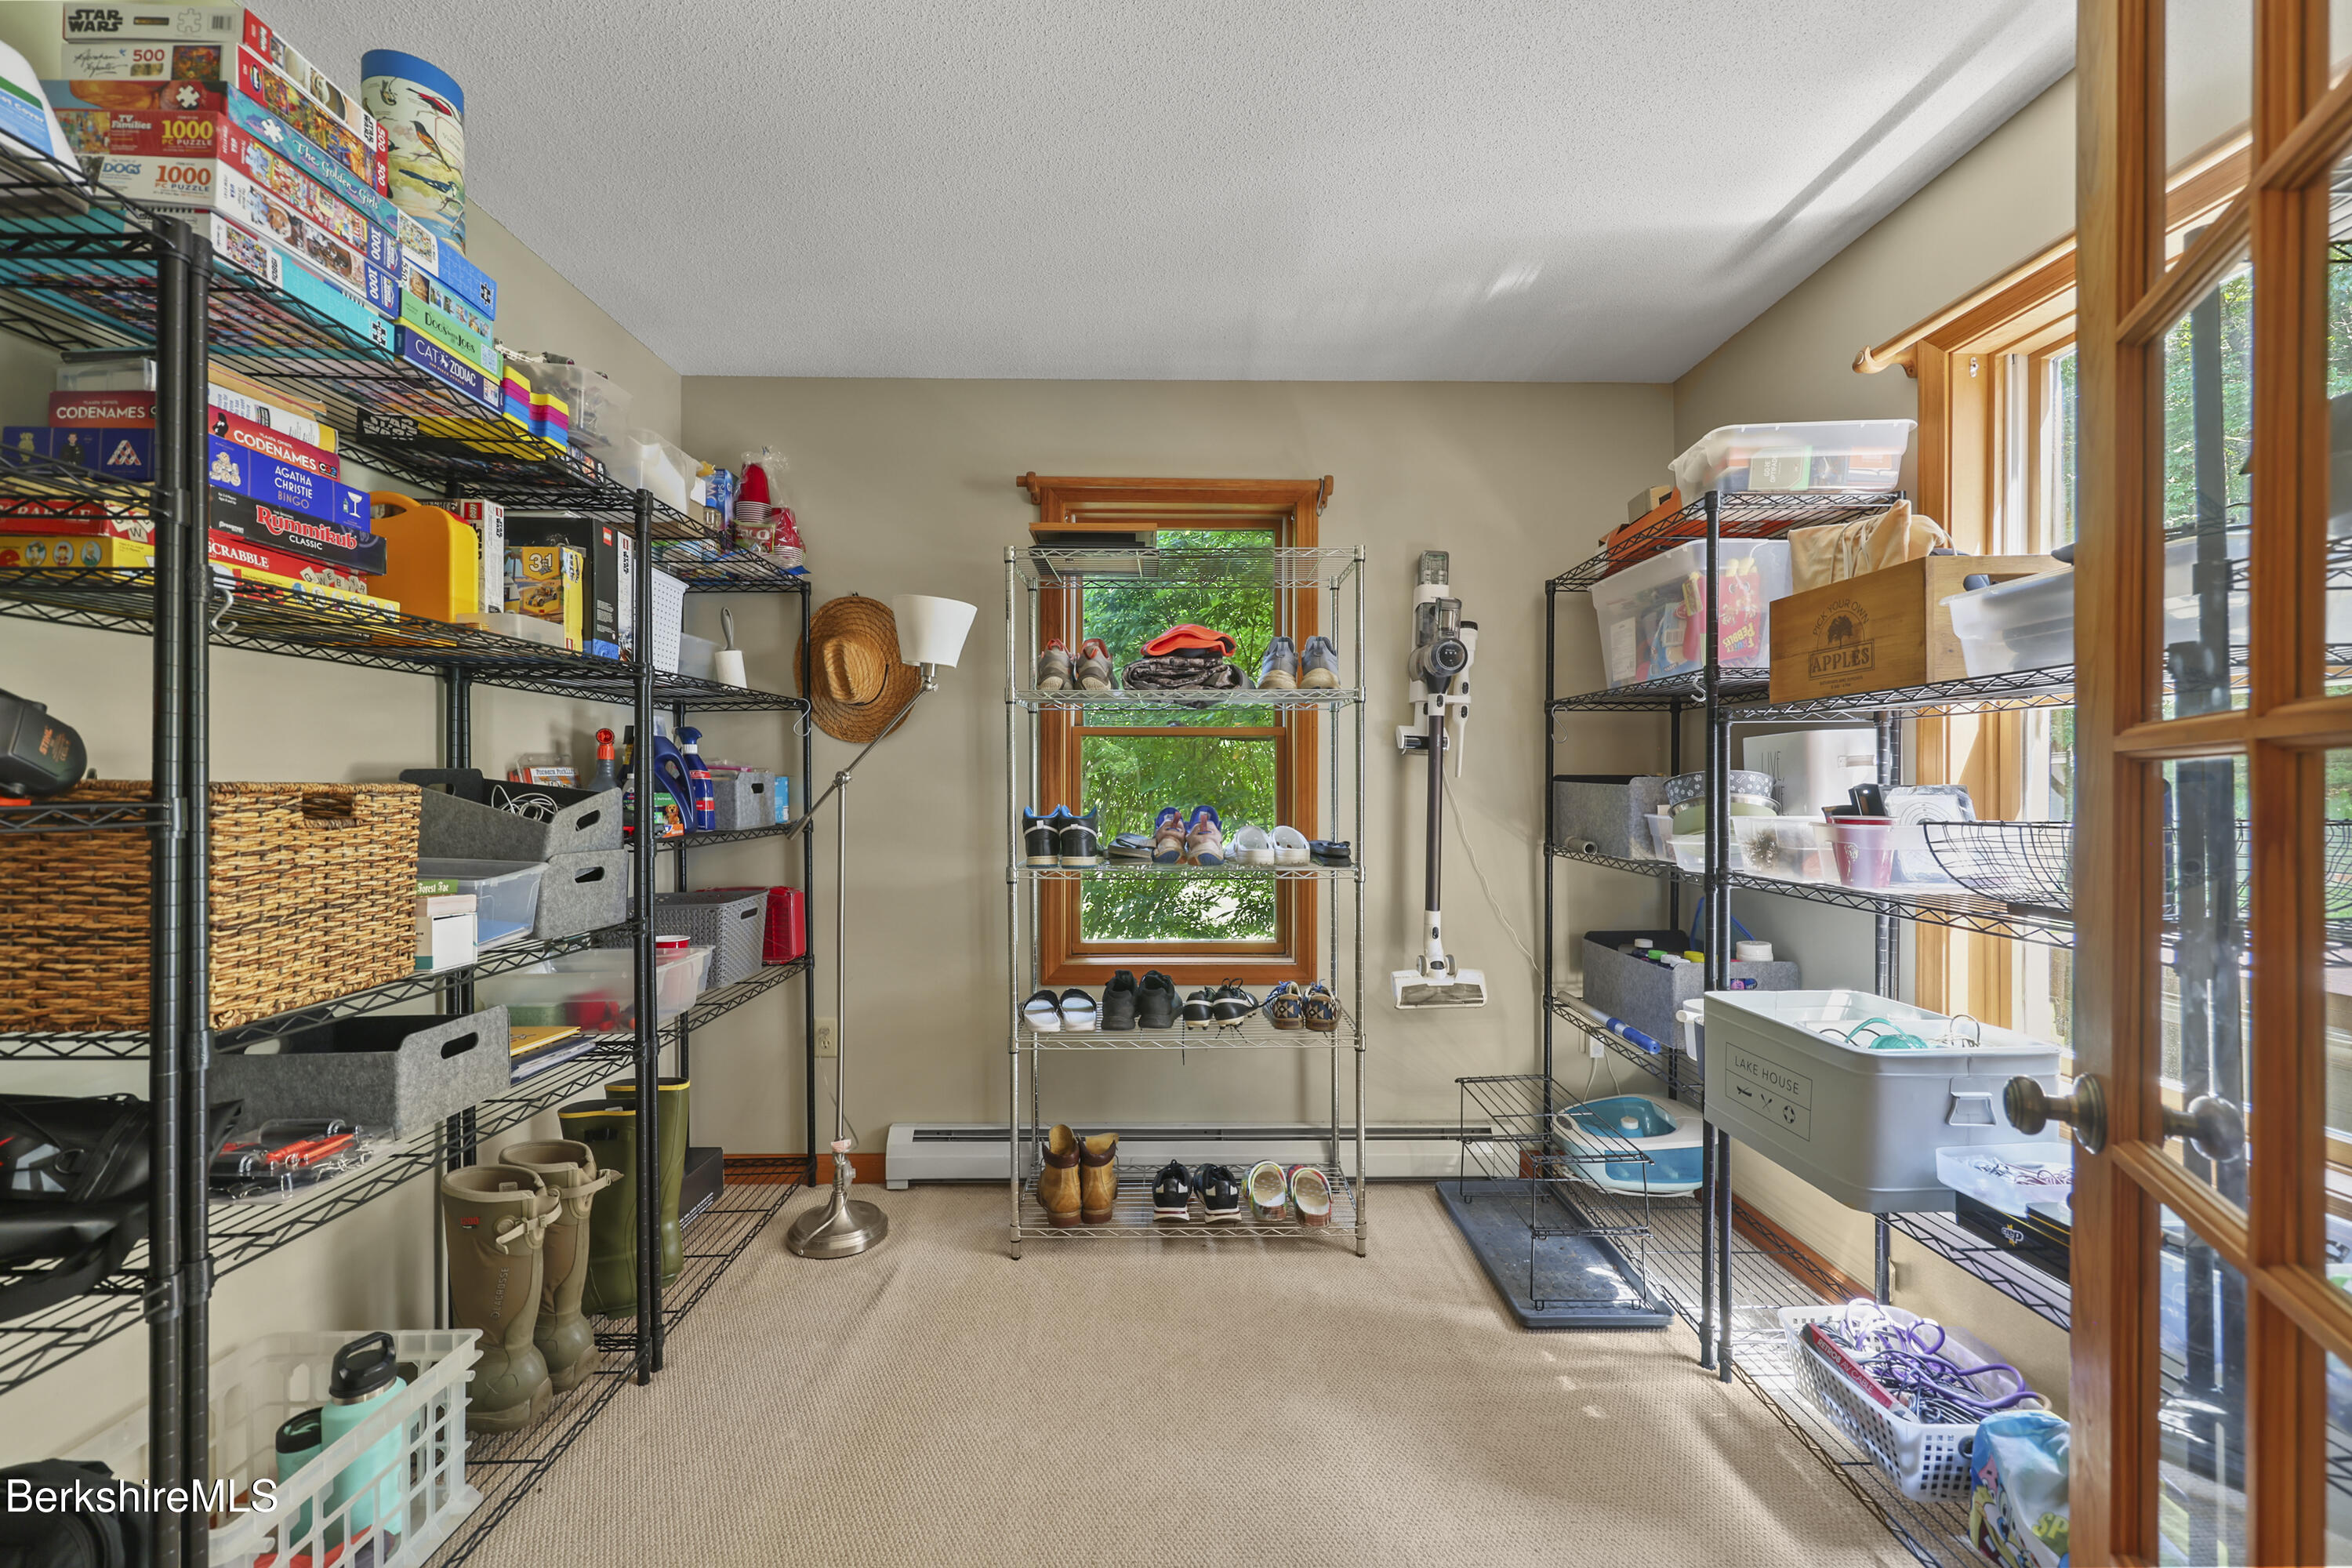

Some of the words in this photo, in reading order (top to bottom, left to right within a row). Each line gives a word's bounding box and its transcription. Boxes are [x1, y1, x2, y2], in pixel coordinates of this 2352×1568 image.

[68, 9, 123, 20] STAR
[68, 21, 123, 32] WARS
[132, 49, 165, 62] 500
[111, 120, 152, 130] Families
[161, 120, 214, 140] 1000
[377, 125, 386, 152] 500
[102, 162, 142, 175] DOGS
[155, 165, 212, 187] 1000
[292, 140, 321, 167] The
[321, 162, 358, 194] Golden
[359, 188, 379, 210] Girls
[377, 162, 386, 187] 500
[170, 183, 210, 192] PUZZLE
[370, 226, 382, 261] 1000
[368, 265, 379, 300] 1000
[425, 312, 448, 336] DOGS
[457, 333, 476, 354] JOBS
[415, 339, 439, 365] CAT
[449, 357, 477, 388] ZODIAC
[56, 406, 146, 419] CODENAMES
[233, 430, 317, 471] CODENAMES
[274, 465, 313, 488] AGATHA
[274, 477, 313, 499] CHRISTIE
[278, 490, 310, 510] BINGO
[256, 504, 358, 550] Rummikub
[289, 534, 323, 551] CLASSIC
[1813, 612, 1828, 636] PICK
[1828, 598, 1850, 613] YOUR
[1851, 601, 1870, 624] OWN
[1811, 648, 1870, 673] APPLES
[417, 882, 437, 895] Forest
[1735, 1055, 1758, 1076] LAKE
[1762, 1067, 1799, 1095] HOUSE
[493, 1266, 510, 1312] LACROSSE
[1851, 1370, 1875, 1393] CABLE
